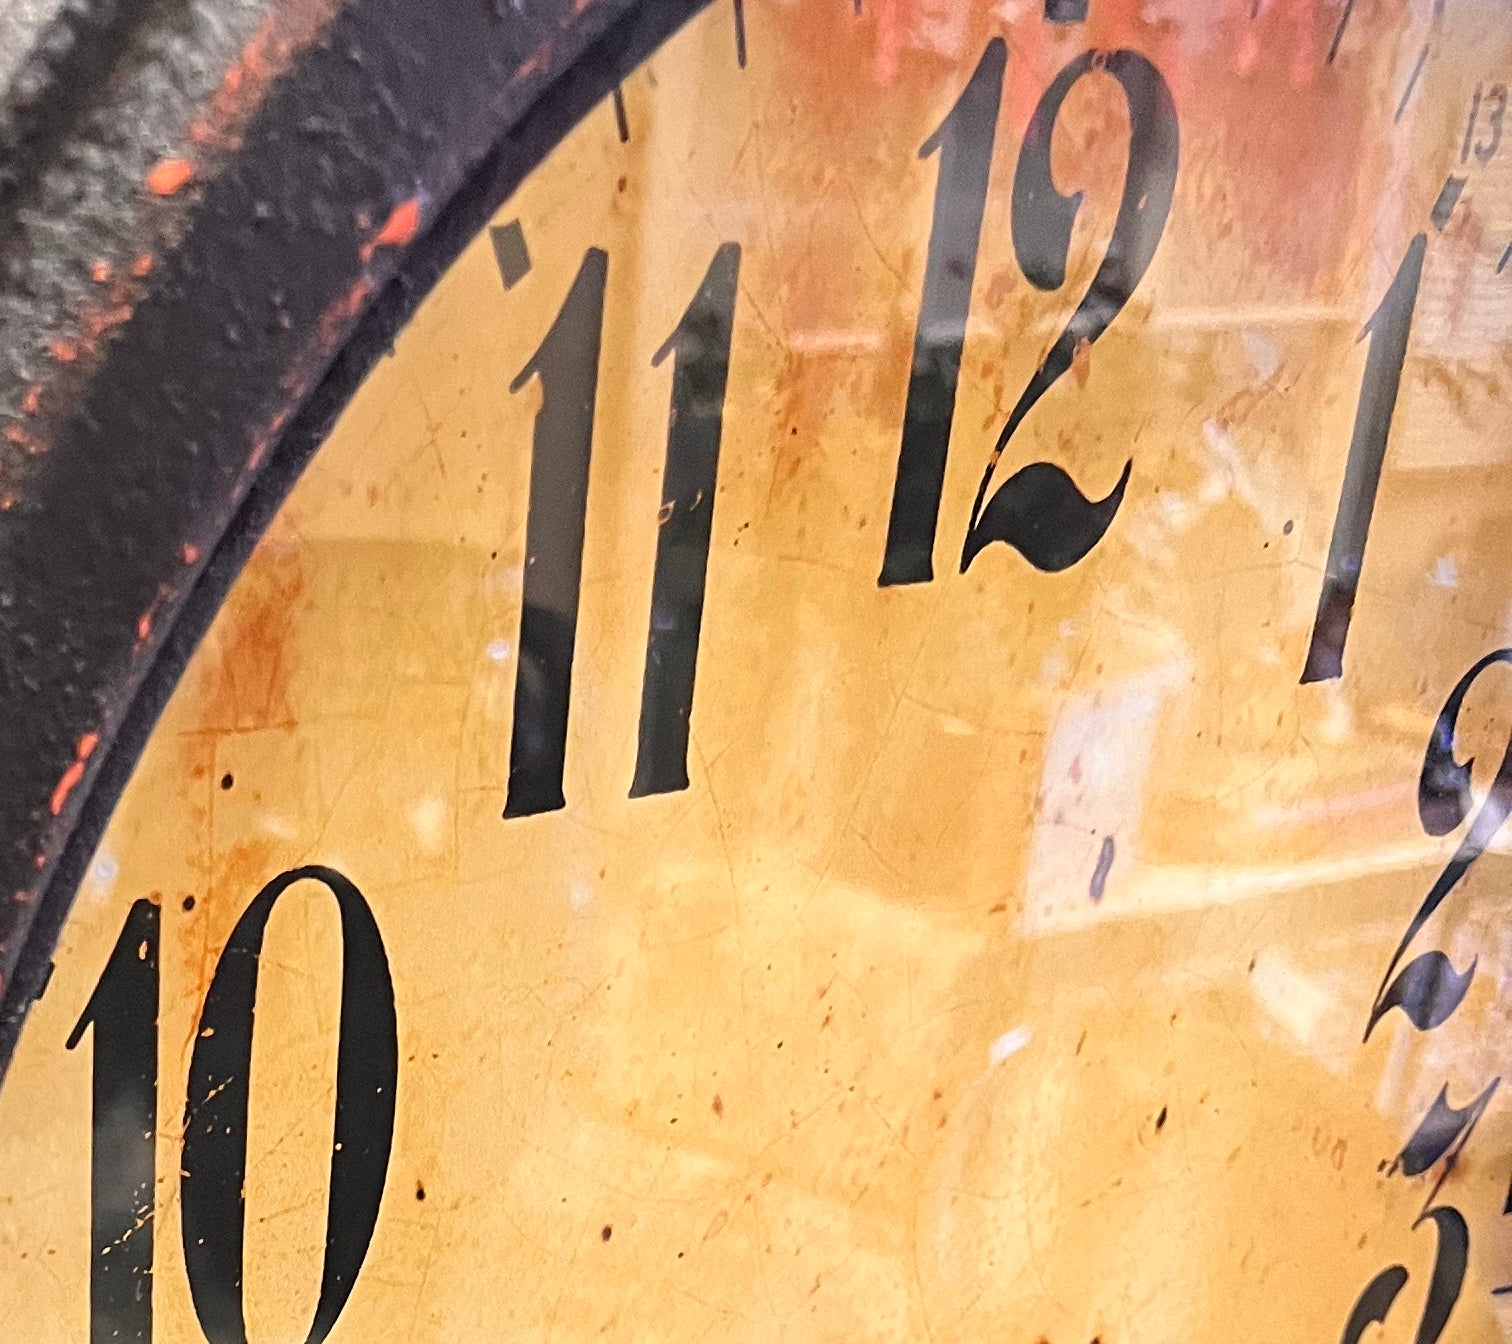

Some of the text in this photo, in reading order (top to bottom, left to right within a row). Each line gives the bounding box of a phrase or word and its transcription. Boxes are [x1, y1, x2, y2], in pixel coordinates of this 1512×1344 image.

[876, 36, 1180, 588] 12
[1461, 80, 1508, 164] 13
[501, 242, 742, 820] 11
[1299, 232, 1428, 686] 1
[1361, 646, 1512, 1044] 2
